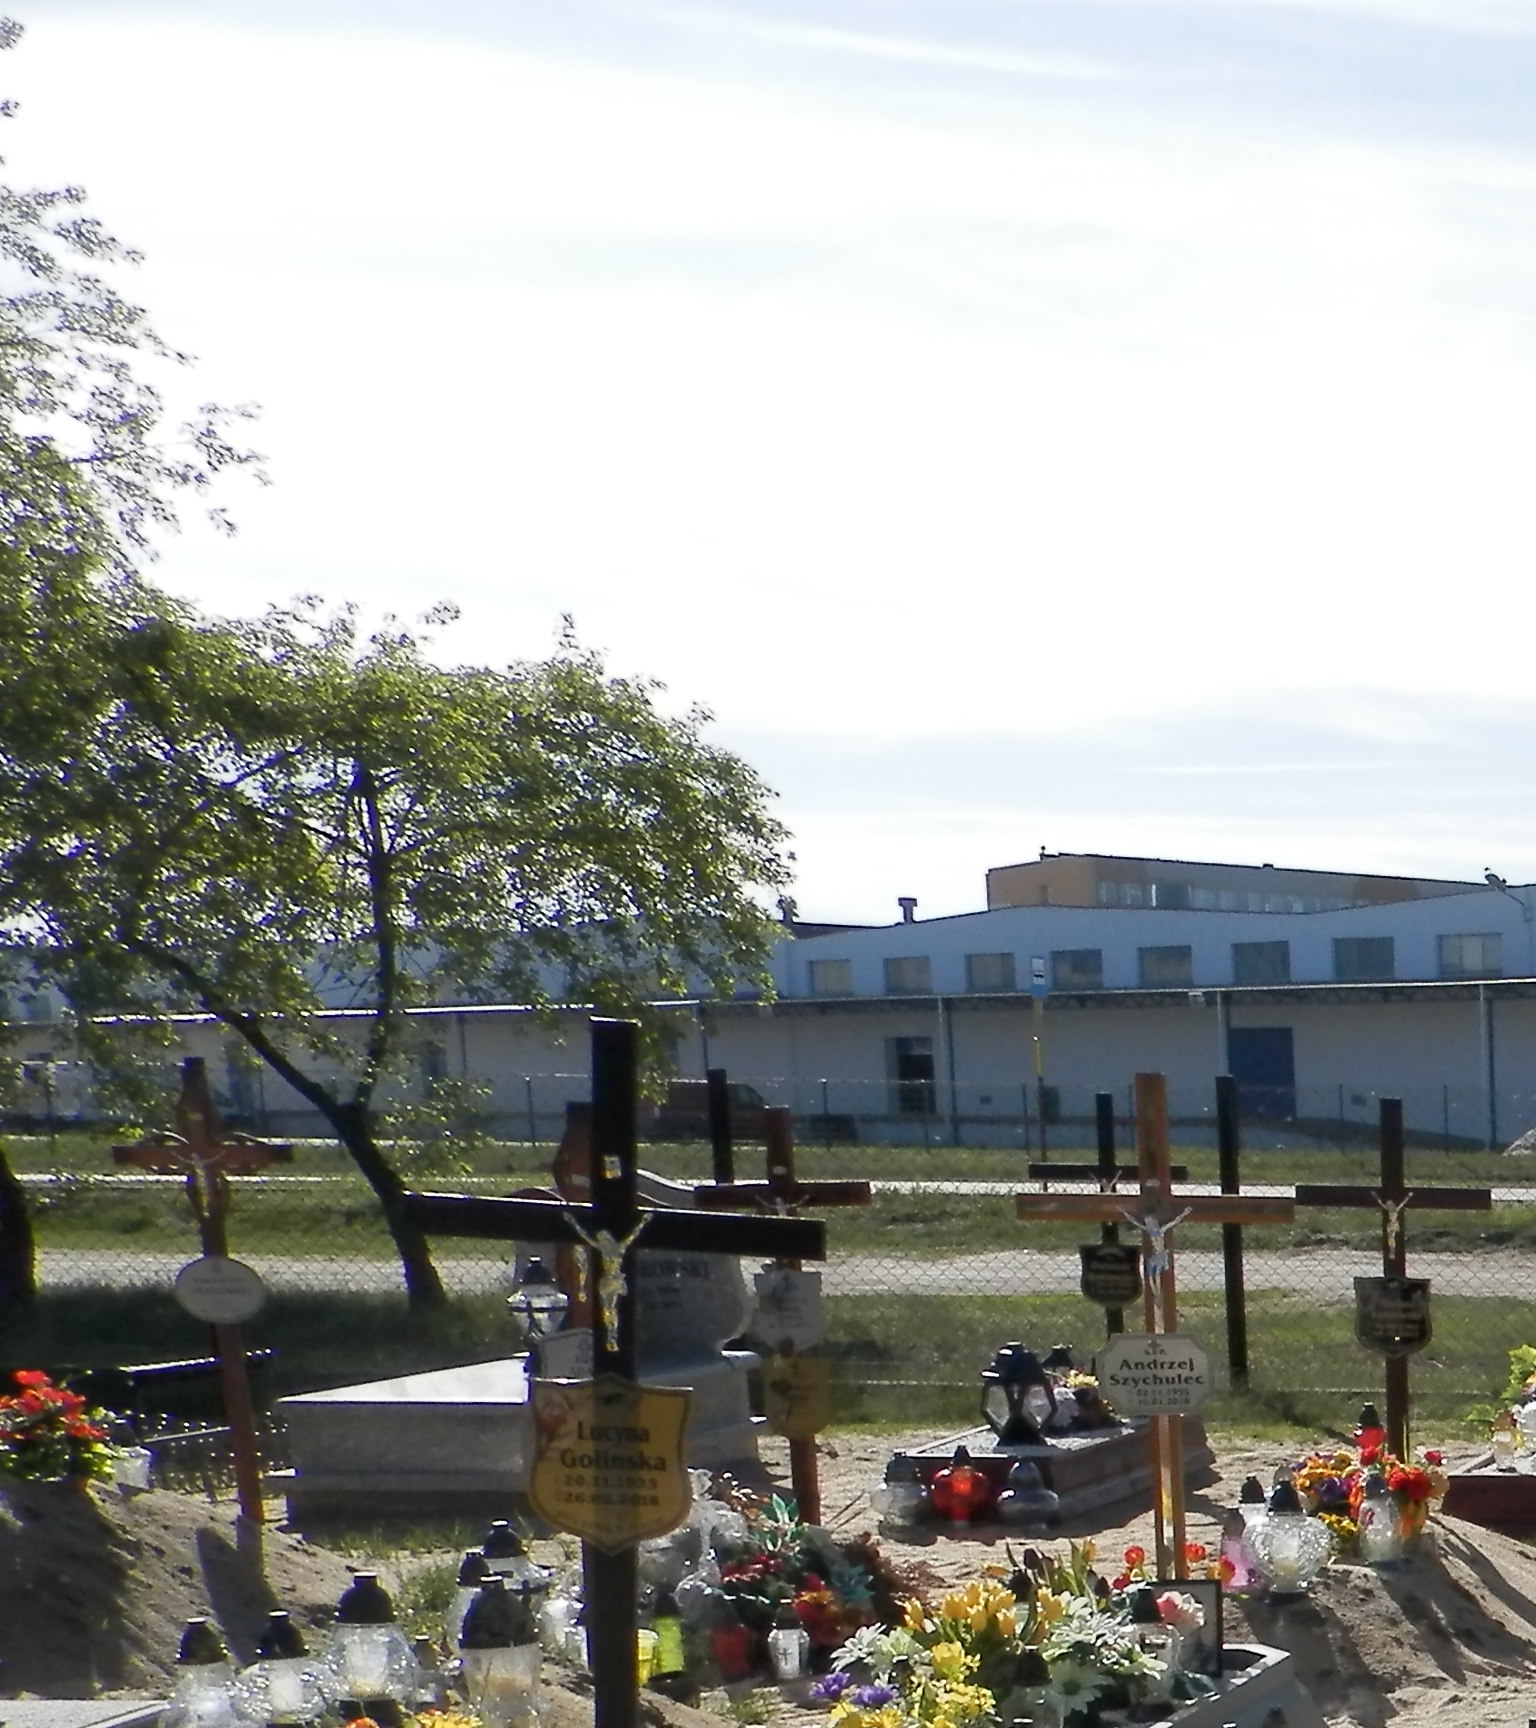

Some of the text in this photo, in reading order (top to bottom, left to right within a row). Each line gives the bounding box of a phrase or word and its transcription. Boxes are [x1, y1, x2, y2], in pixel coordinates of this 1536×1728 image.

[1119, 1357, 1195, 1373] Andrzej
[1109, 1373, 1205, 1389] Szychulec
[577, 1420, 651, 1447] Lucyna
